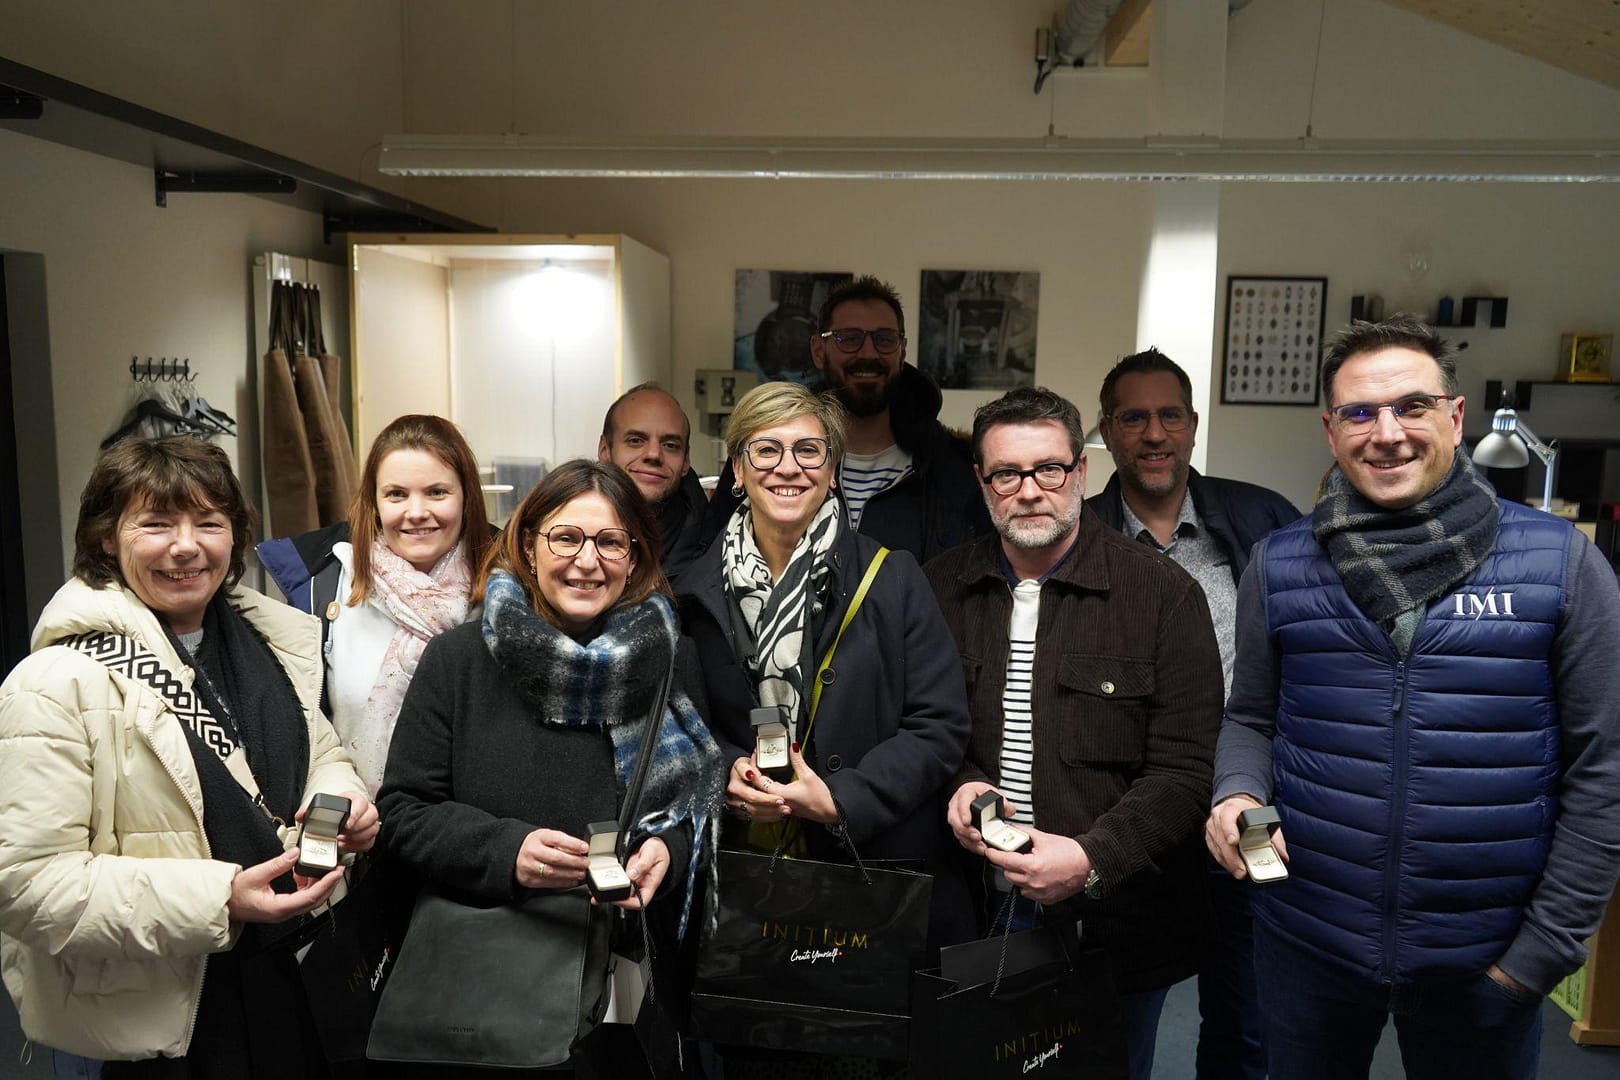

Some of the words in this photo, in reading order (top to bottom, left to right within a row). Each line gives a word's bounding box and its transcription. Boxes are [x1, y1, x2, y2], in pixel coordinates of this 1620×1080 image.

[1453, 586, 1514, 620] IMI
[762, 920, 869, 949] INITIUM
[994, 1020, 1081, 1061] INITIUM
